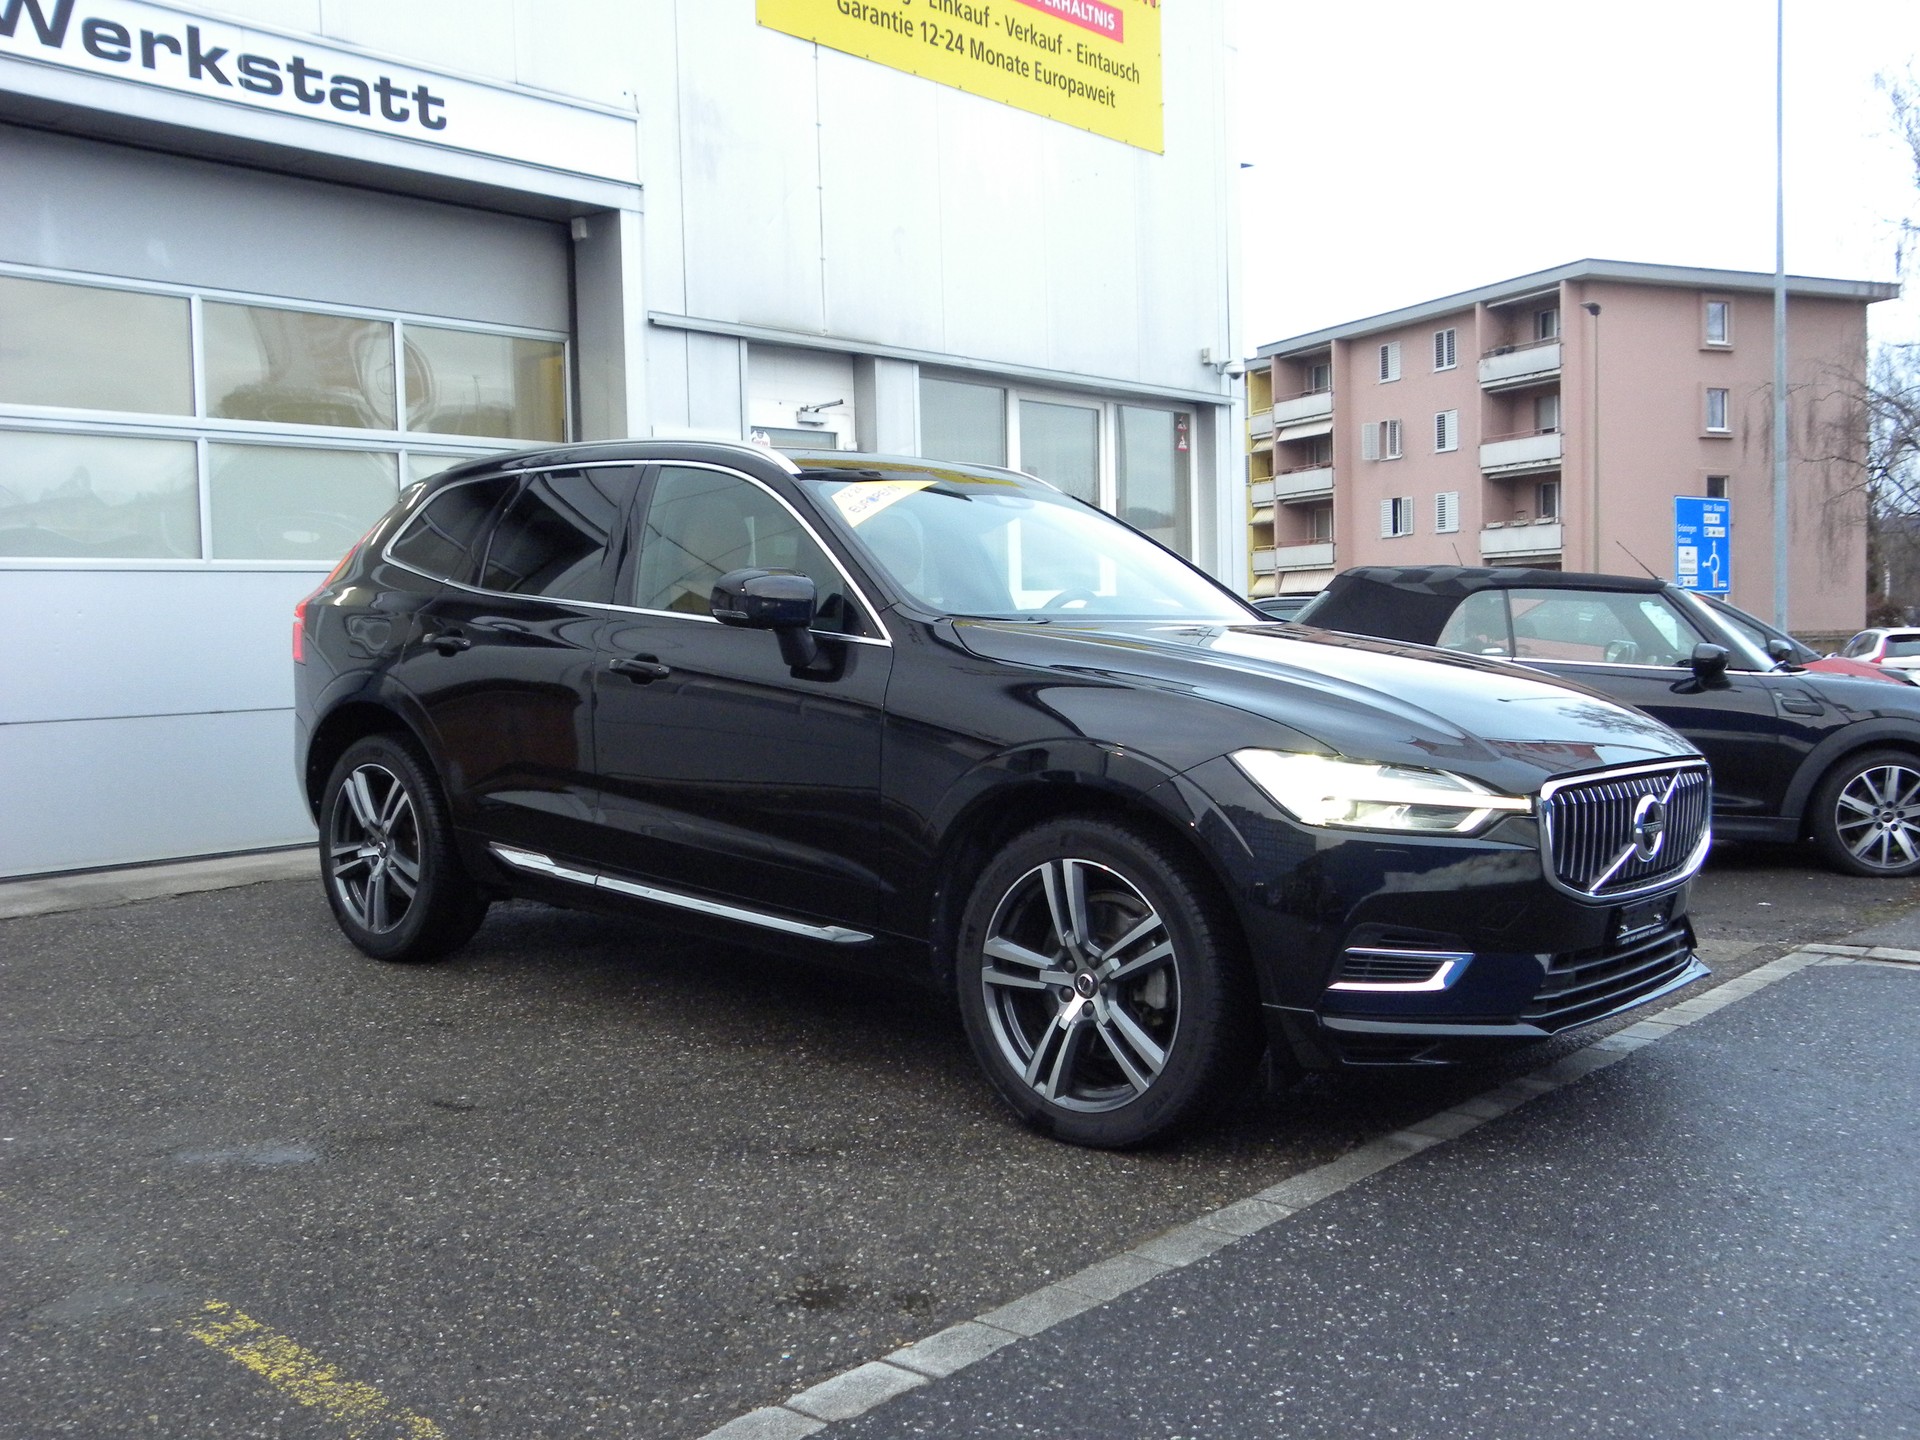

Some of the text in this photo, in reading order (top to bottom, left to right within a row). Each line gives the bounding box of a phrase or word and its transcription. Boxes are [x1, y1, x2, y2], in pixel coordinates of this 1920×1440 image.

[0, 0, 447, 131] Werkstatt
[837, 0, 1116, 108] Garantie 12-24 Monate Europaweit
[1004, 15, 1063, 55] Verkauf
[1076, 43, 1140, 84] Eintausch
